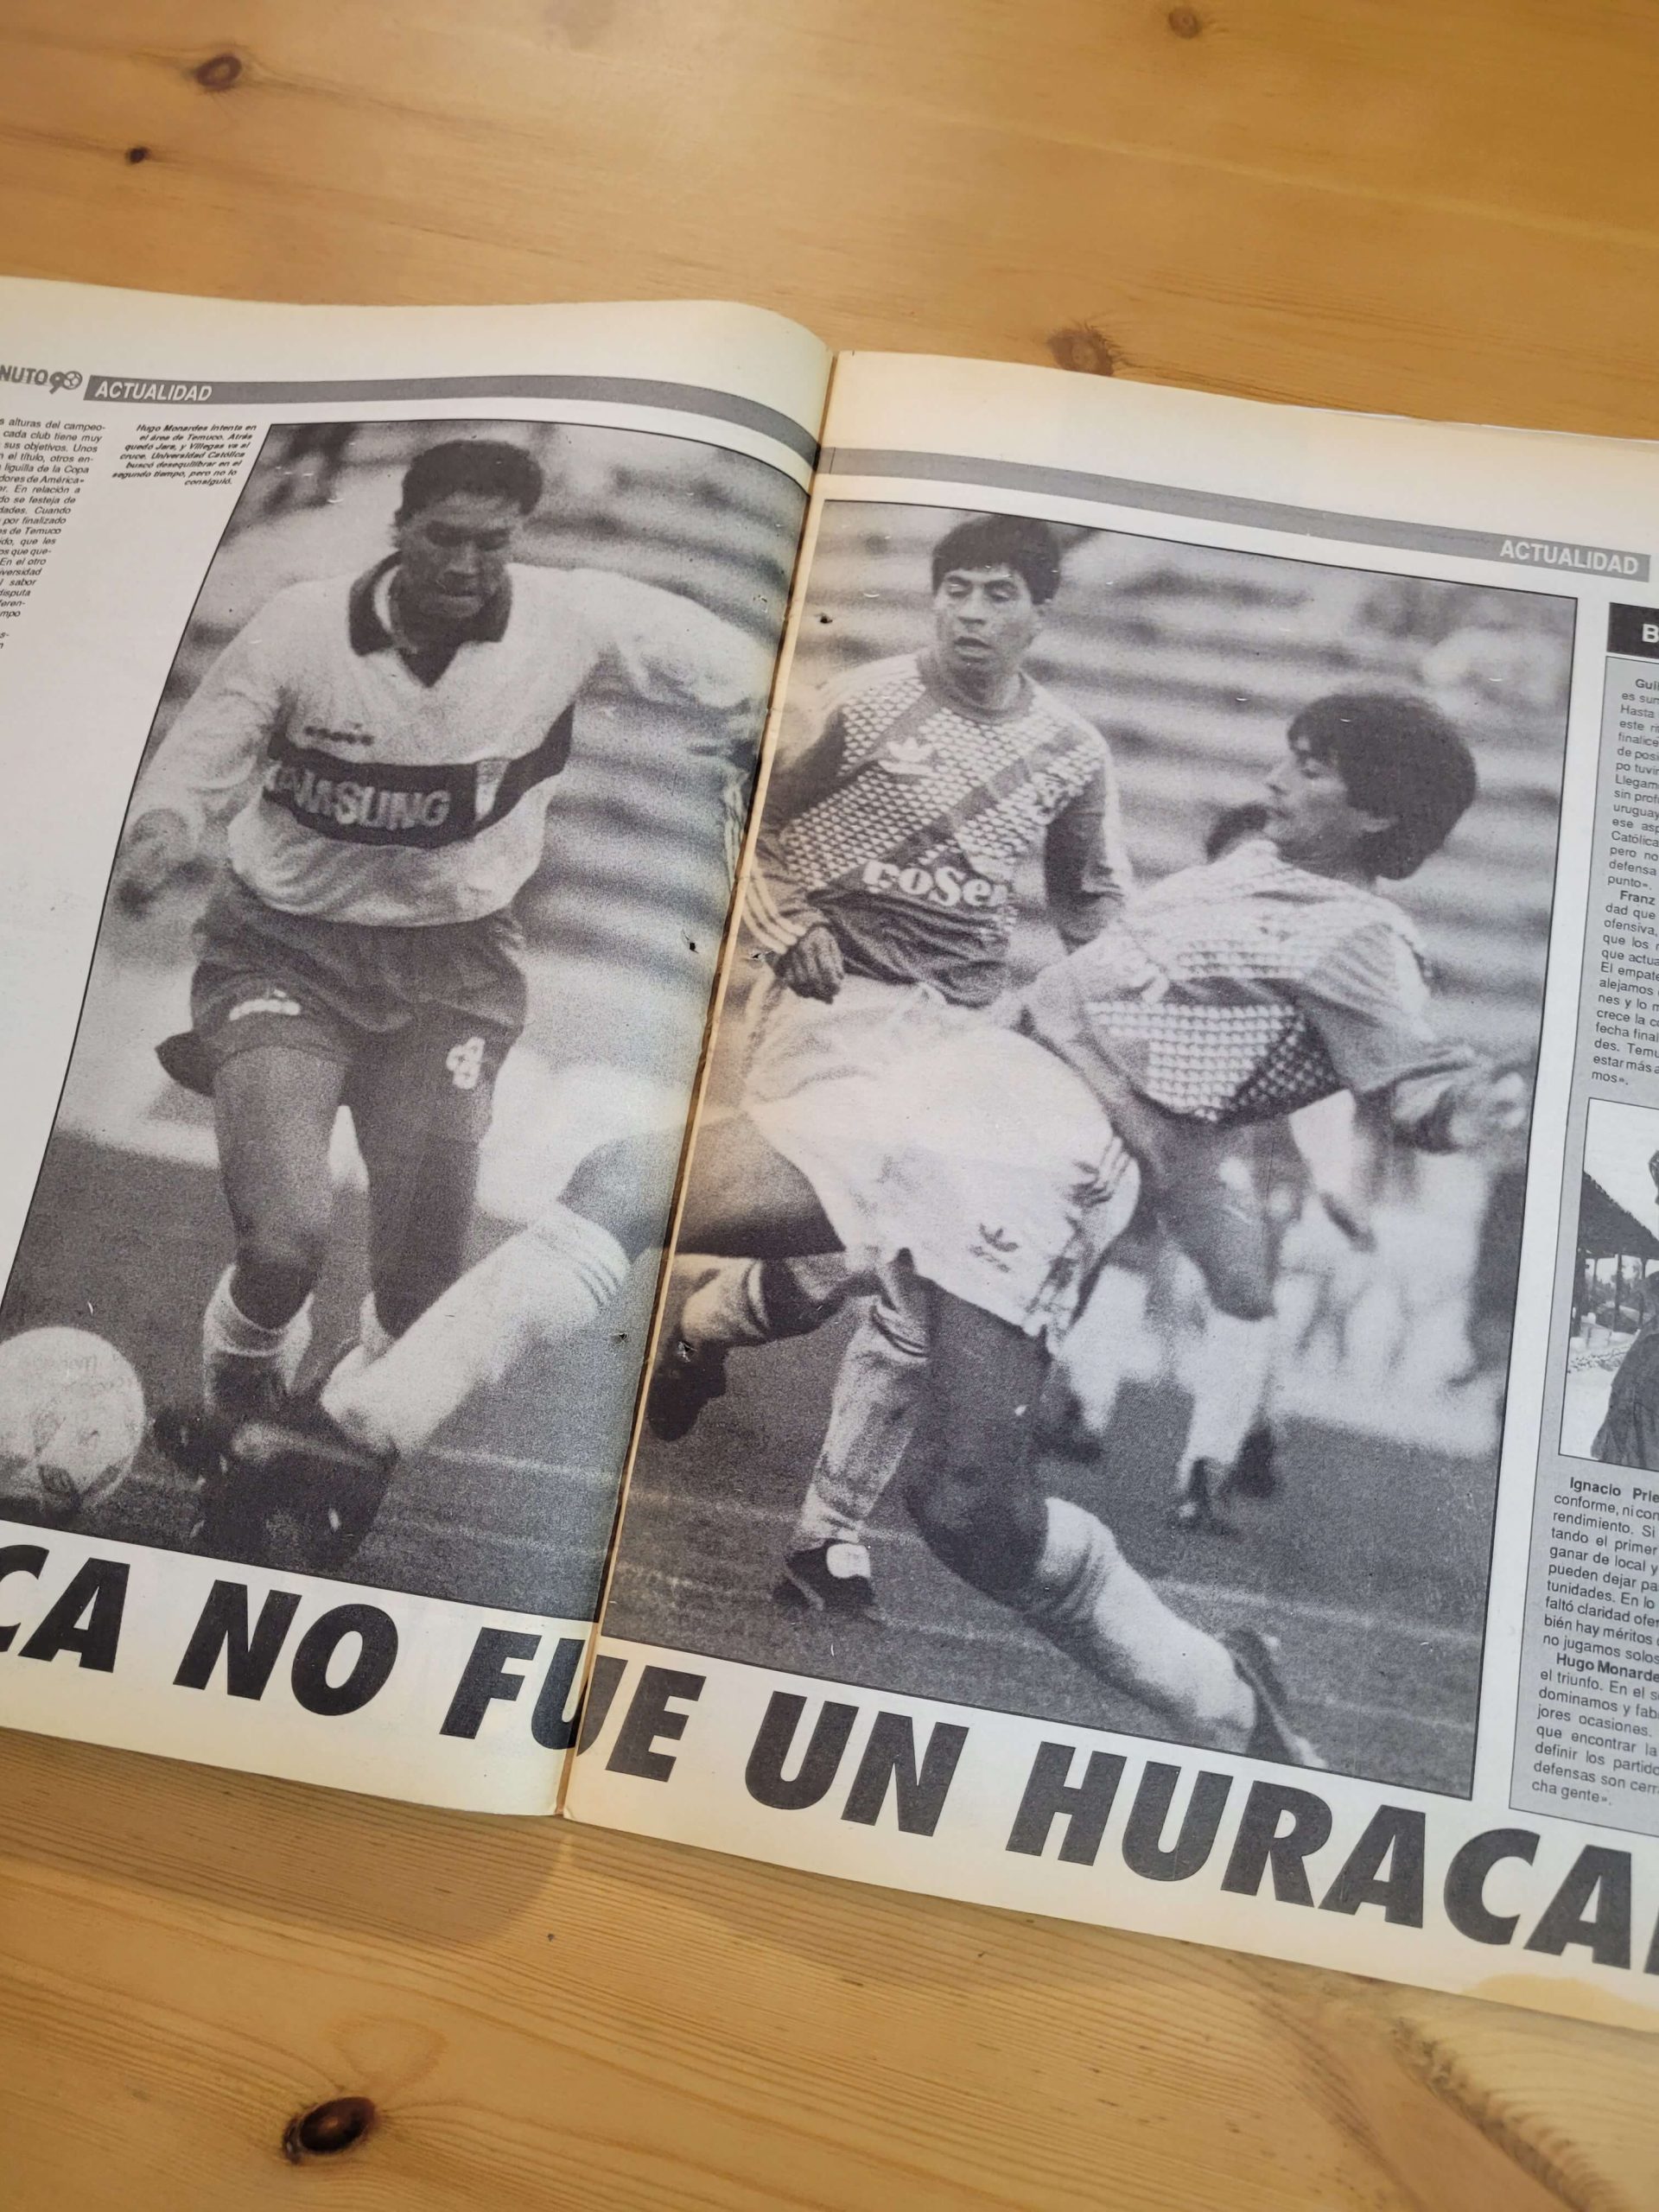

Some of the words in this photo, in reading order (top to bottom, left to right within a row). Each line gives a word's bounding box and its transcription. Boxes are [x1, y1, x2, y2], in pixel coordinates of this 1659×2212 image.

[95, 380, 213, 402] ACTUALIDAD
[9, 416, 41, 428] alturas
[45, 420, 60, 429] del
[64, 423, 105, 432] campeo-
[136, 423, 162, 433] Hugo
[3, 429, 27, 438] cada
[54, 433, 78, 442] tiene
[81, 435, 103, 444] muy
[24, 442, 68, 453] objetivos.
[73, 444, 98, 453] Unos
[188, 442, 226, 451] Villegas
[8, 452, 17, 461] el
[21, 453, 46, 463] título,
[150, 451, 205, 460] Universidad
[37, 464, 49, 473] de
[52, 465, 61, 474] la
[64, 467, 90, 476] Copa
[111, 470, 152, 480] segundo
[188, 470, 211, 479] pero
[27, 475, 39, 484] de
[14, 484, 28, 493] En
[32, 486, 70, 494] relación
[29, 496, 60, 505] festeja
[35, 506, 72, 515] Cuando
[3, 518, 20, 526] por
[22, 517, 67, 525] finalizado
[25, 526, 62, 536] Temuco
[20, 538, 39, 547] que
[42, 537, 57, 545] les
[10, 548, 29, 557] que
[30, 548, 52, 557] que-
[1499, 539, 1640, 575] ACTUALIDAD
[16, 557, 26, 566] el
[9, 577, 37, 587] sabor
[1621, 692, 1636, 702] es
[1619, 703, 1655, 719] Hasta
[1618, 721, 1645, 731] este
[1617, 746, 1632, 757] de
[1616, 762, 1631, 772] po
[1614, 789, 1631, 799] sin
[1612, 818, 1633, 829] ese
[1611, 830, 1659, 848] Católica
[1610, 847, 1637, 858] pero
[1644, 852, 1659, 861] no
[1609, 859, 1657, 876] defensa
[1620, 890, 1656, 906] Franz
[1605, 903, 1629, 916] dad
[1632, 909, 1656, 920] que
[1604, 918, 1659, 937] ofensiva,
[1603, 934, 1625, 945] que
[1631, 937, 1649, 950] los
[1601, 949, 1624, 960] que
[1600, 961, 1613, 974] El
[1599, 978, 1654, 995] alejamos
[1598, 994, 1620, 1006] nes
[1624, 999, 1632, 1009] y
[1636, 998, 1648, 1010] lo
[1596, 1009, 1630, 1022] crece
[1635, 1013, 1645, 1026] la
[1595, 1021, 1630, 1038] fecha
[1633, 1028, 1659, 1043] final
[1593, 1038, 1620, 1052] des.
[1592, 1055, 1624, 1068] estar
[1625, 1059, 1652, 1072] más
[1569, 1476, 1622, 1497] Ignacio
[1554, 1494, 1619, 1516] conforme,
[1622, 1504, 1635, 1517] ni
[1553, 1512, 1634, 1535] rendimiento.
[1642, 1524, 1656, 1539] Si
[1551, 1527, 1589, 1544] tando
[1596, 1535, 1608, 1548] el
[1614, 1539, 1658, 1556] primer
[1549, 1546, 1589, 1562] ganar
[1592, 1552, 1610, 1566] de
[1614, 1554, 1646, 1572] local
[1650, 1564, 1659, 1577] y
[1548, 1563, 1599, 1581] pueden
[1602, 1571, 1637, 1589] dejar
[1547, 1580, 1616, 1603] tunidades.
[1620, 1592, 1639, 1607] En
[1643, 1595, 1656, 1610] lo
[1545, 1595, 1574, 1613] faltó
[1577, 1601, 1630, 1623] claridad
[1544, 1614, 1573, 1631] bién
[1576, 1621, 1600, 1638] hay
[1603, 1627, 1653, 1645] méritos
[1542, 1635, 1560, 1646] no
[1563, 1636, 1621, 1658] jugamos
[1556, 1651, 1595, 1674] Hugo
[1540, 1669, 1553, 1681] el
[1557, 1671, 1603, 1691] triunfo.
[1609, 1680, 1628, 1695] En
[1632, 1686, 1645, 1700] el
[1538, 1687, 1618, 1713] dominamos
[1623, 1702, 1631, 1718] y
[1537, 1706, 1572, 1722] jores
[1579, 1714, 1653, 1738] ocasiones.
[1535, 1726, 1562, 1740] que
[1571, 1731, 1637, 1753] encontrar
[1645, 1741, 1658, 1758] la
[1535, 1741, 1579, 1761] definir
[1586, 1748, 1605, 1765] los
[173, 1580, 399, 1717] NO
[744, 1690, 970, 1838] UN
[1005, 1741, 1659, 1976] HURACA
[1533, 1760, 1596, 1783] defensas
[1600, 1774, 1626, 1789] son
[1531, 1779, 1558, 1796] cha
[1560, 1786, 1613, 1806] gente».
